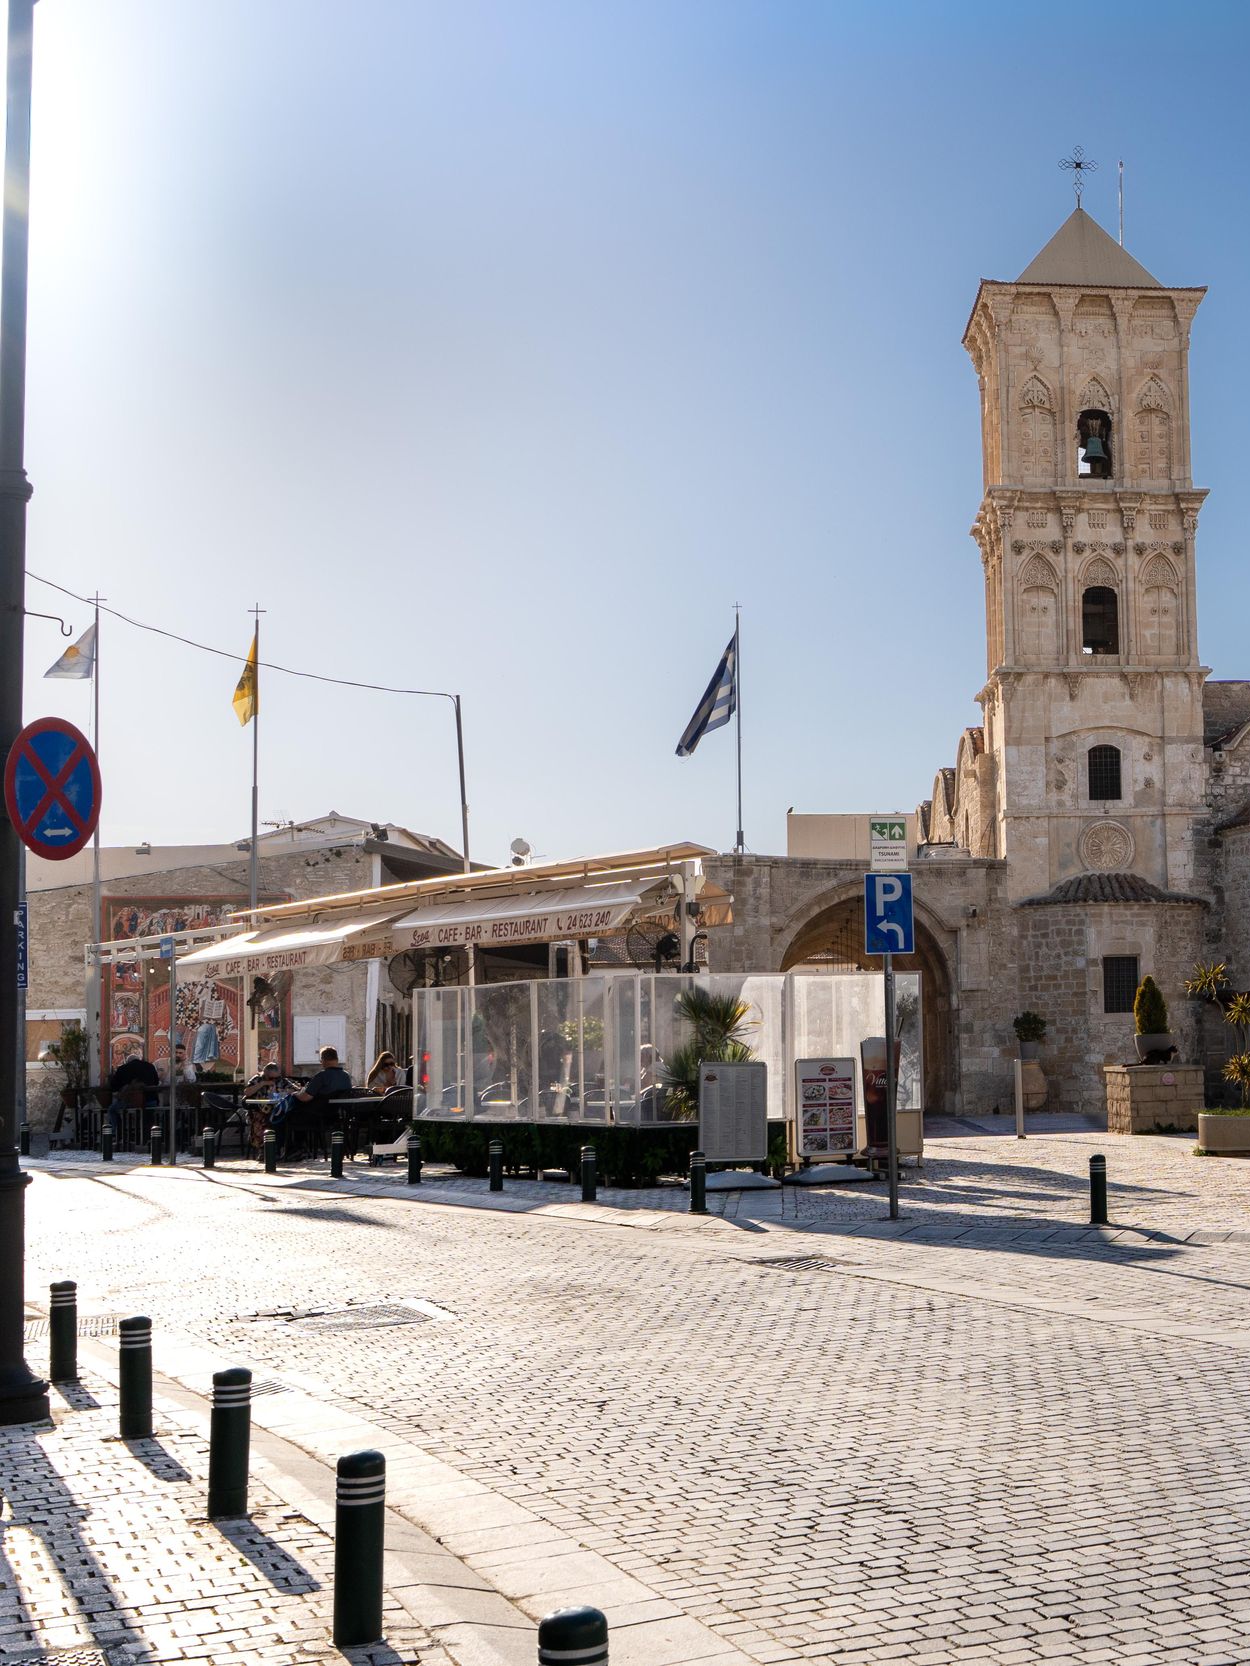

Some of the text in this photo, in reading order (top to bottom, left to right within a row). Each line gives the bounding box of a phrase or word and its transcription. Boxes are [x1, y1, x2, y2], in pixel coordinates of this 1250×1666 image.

[875, 876, 903, 916] P
[437, 927, 459, 943] CAFE
[465, 925, 482, 941] BAR
[491, 917, 549, 938] RESTAURANT
[567, 915, 577, 930] 24
[579, 913, 592, 929] 623
[594, 910, 611, 927] 240
[225, 960, 241, 975] CAFE
[247, 958, 260, 972] BAR
[266, 951, 307, 969] RESTAURANT
